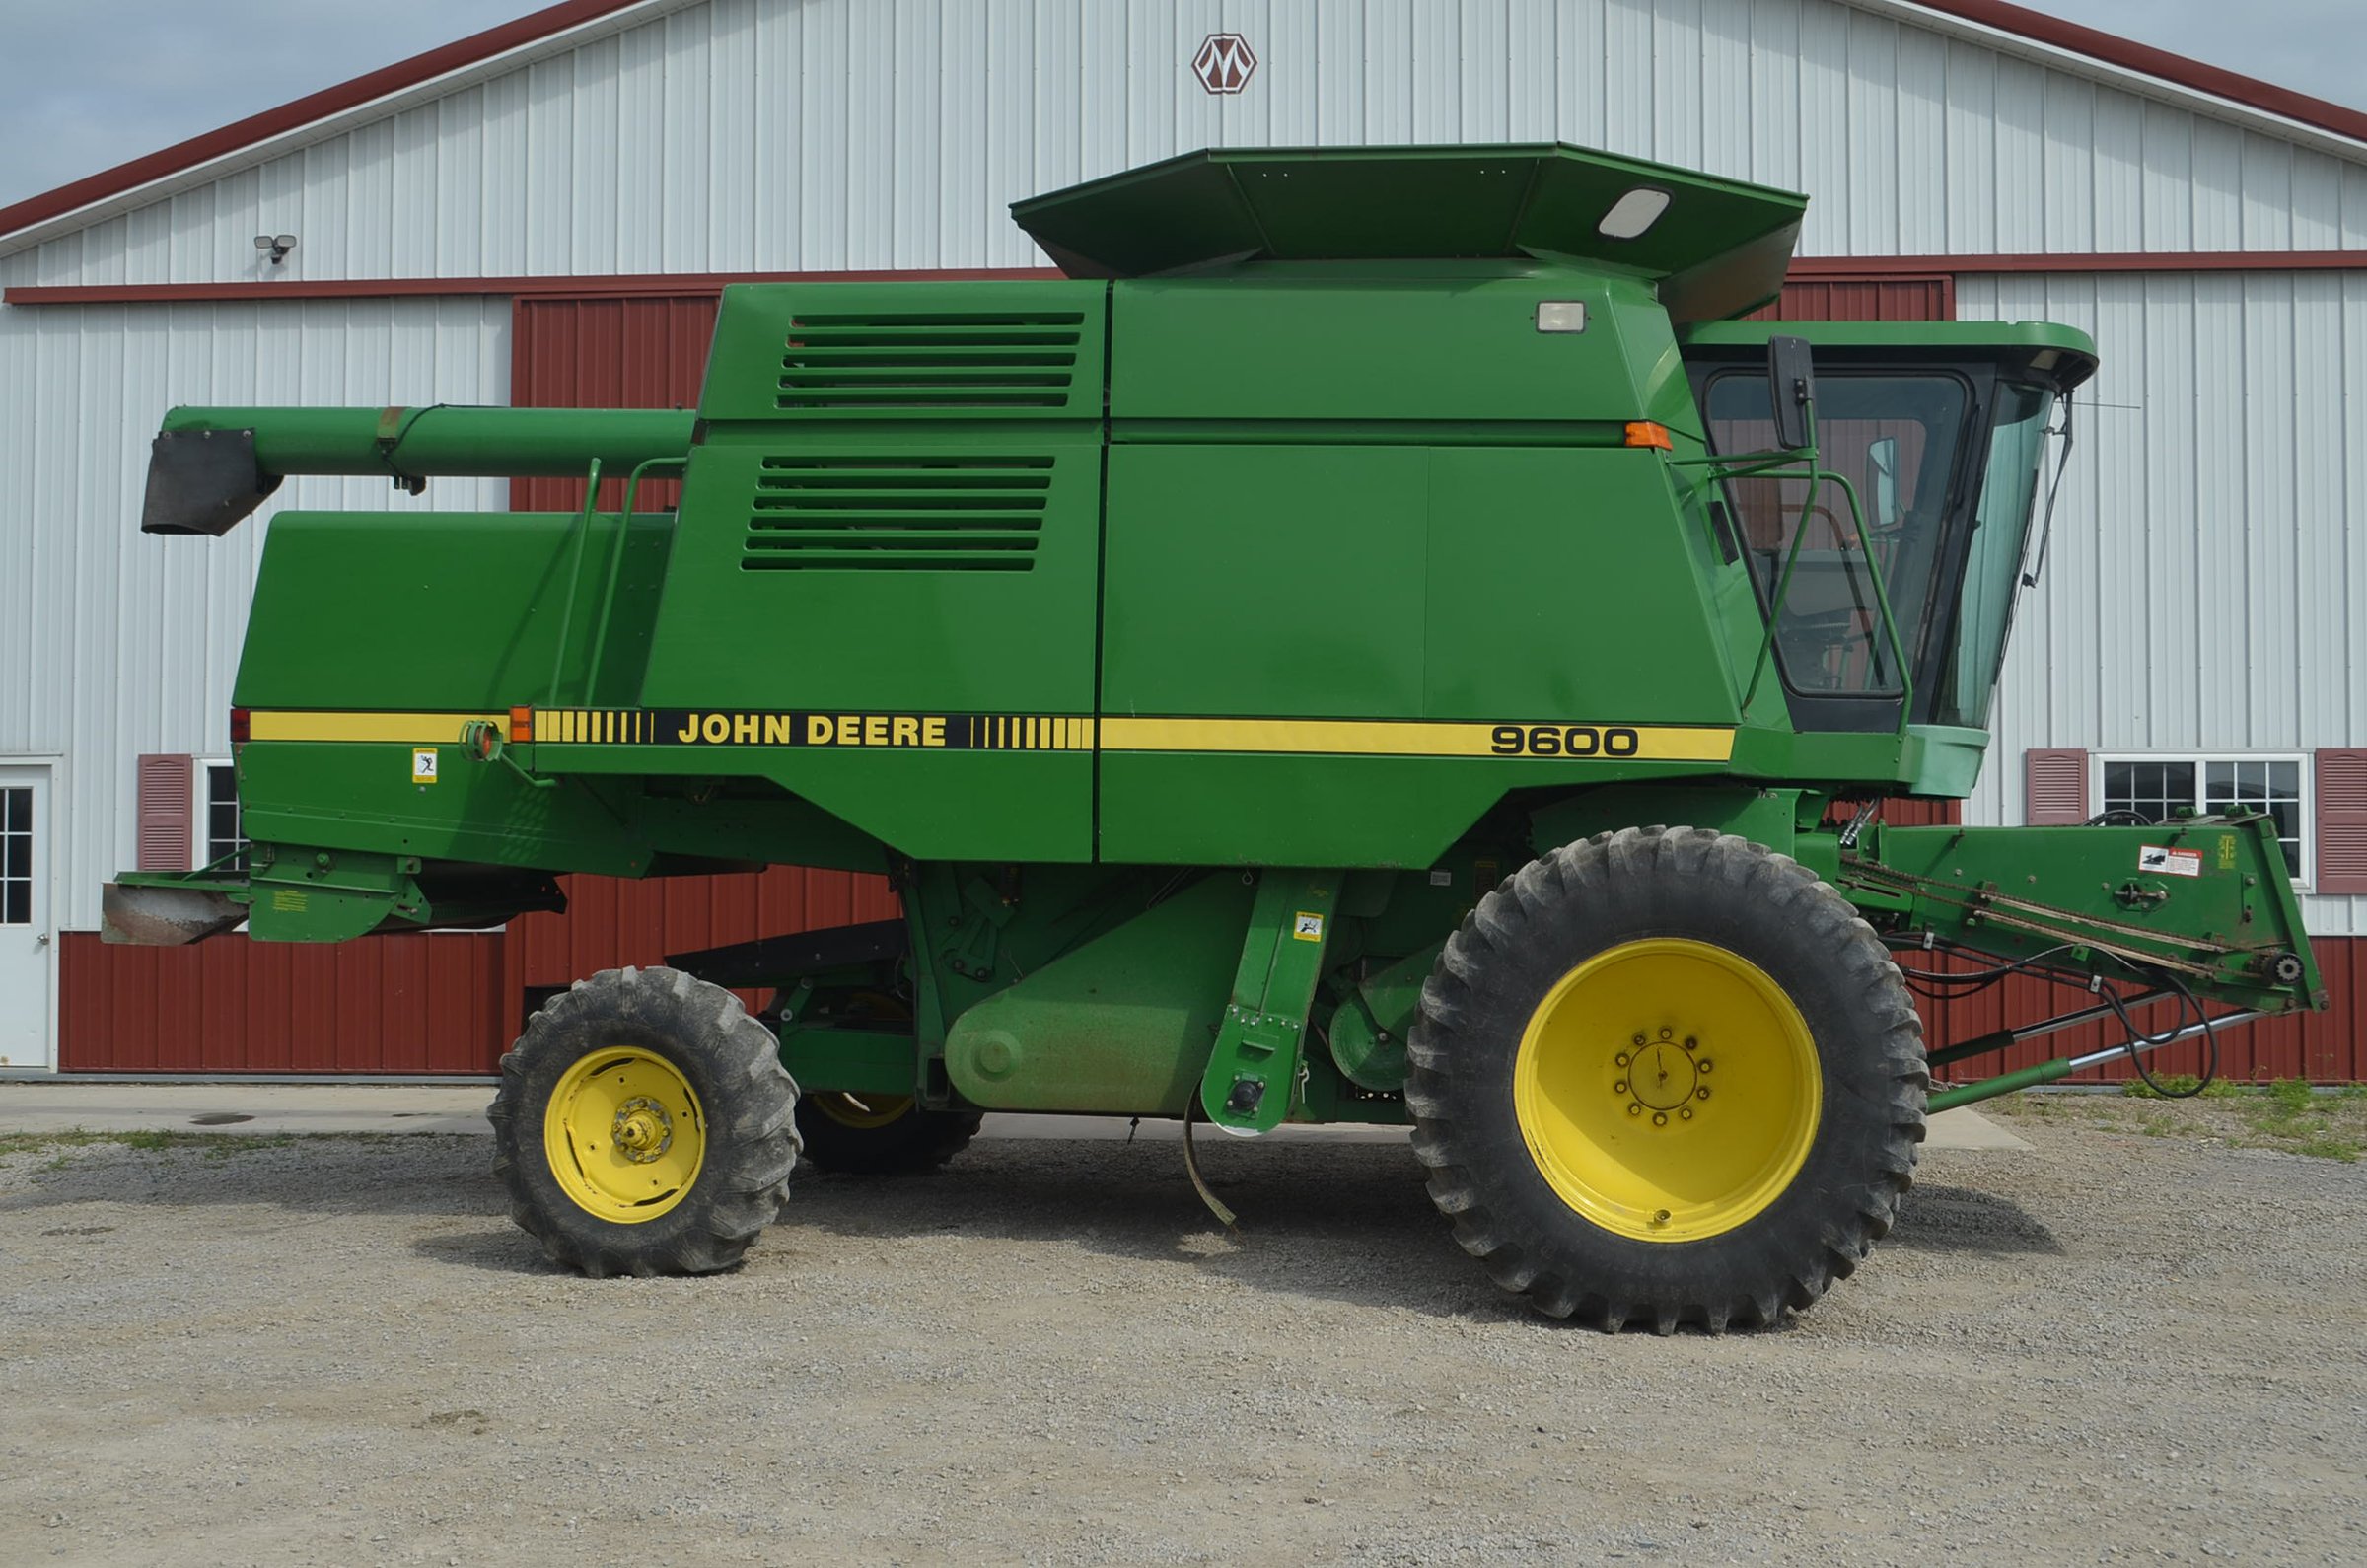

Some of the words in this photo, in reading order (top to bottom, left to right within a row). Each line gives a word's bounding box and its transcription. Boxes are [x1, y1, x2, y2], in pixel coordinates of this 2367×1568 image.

[678, 713, 791, 744] JOHN
[807, 715, 947, 747] DEERE
[1491, 726, 1638, 756] 9600
